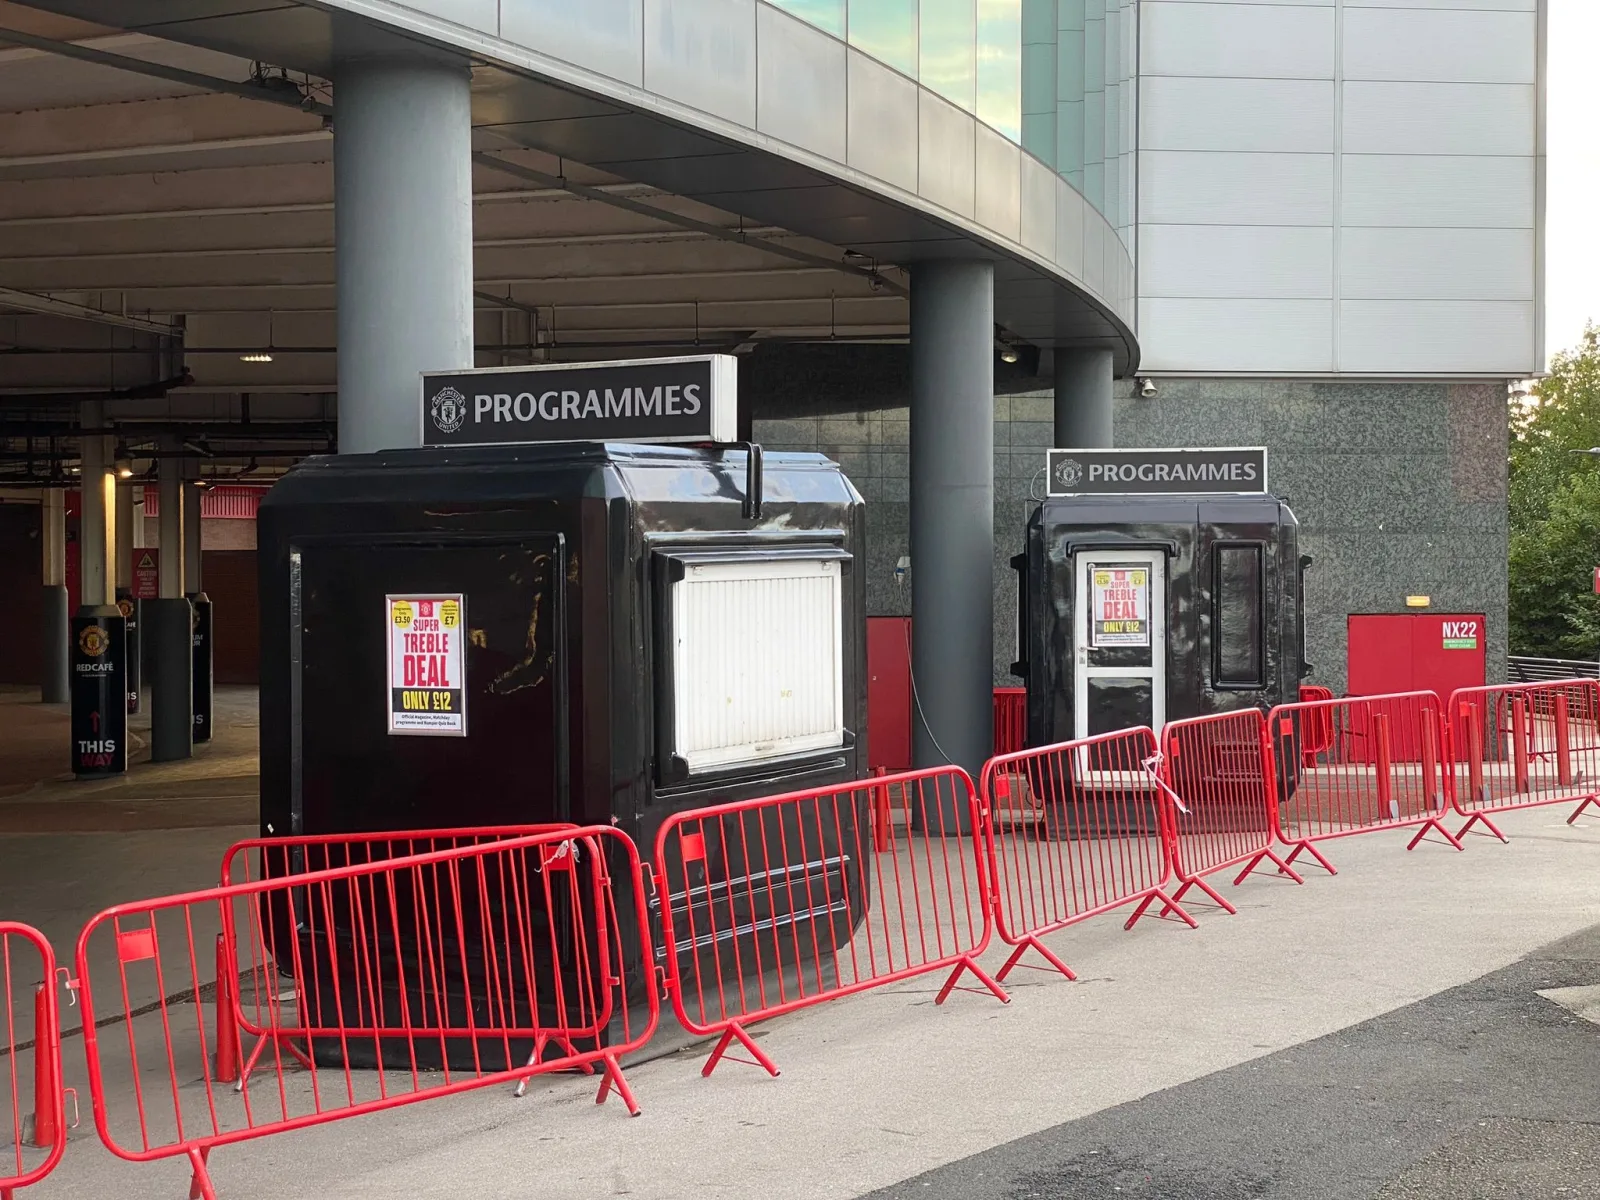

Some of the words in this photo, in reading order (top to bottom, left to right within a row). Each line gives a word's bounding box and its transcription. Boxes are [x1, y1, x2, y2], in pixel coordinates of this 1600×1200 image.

[474, 384, 702, 423] PROGRAMMES
[1088, 462, 1257, 482] PROGRAMMES
[1110, 581, 1130, 589] SUPER
[1103, 589, 1137, 601] TREBLE
[1103, 601, 1138, 619] DEAL
[395, 616, 410, 624] £3.50
[413, 618, 439, 632] SUPER
[445, 616, 454, 625] £7
[1103, 621, 1124, 633] ONLY
[1125, 621, 1140, 633] £12
[1442, 621, 1476, 638] NX22
[404, 633, 449, 653] TREBLE
[404, 655, 450, 687] DEAL
[402, 690, 429, 710] ONLY
[433, 691, 452, 711] £12
[78, 739, 116, 753] THIS
[80, 753, 114, 767] WAY
